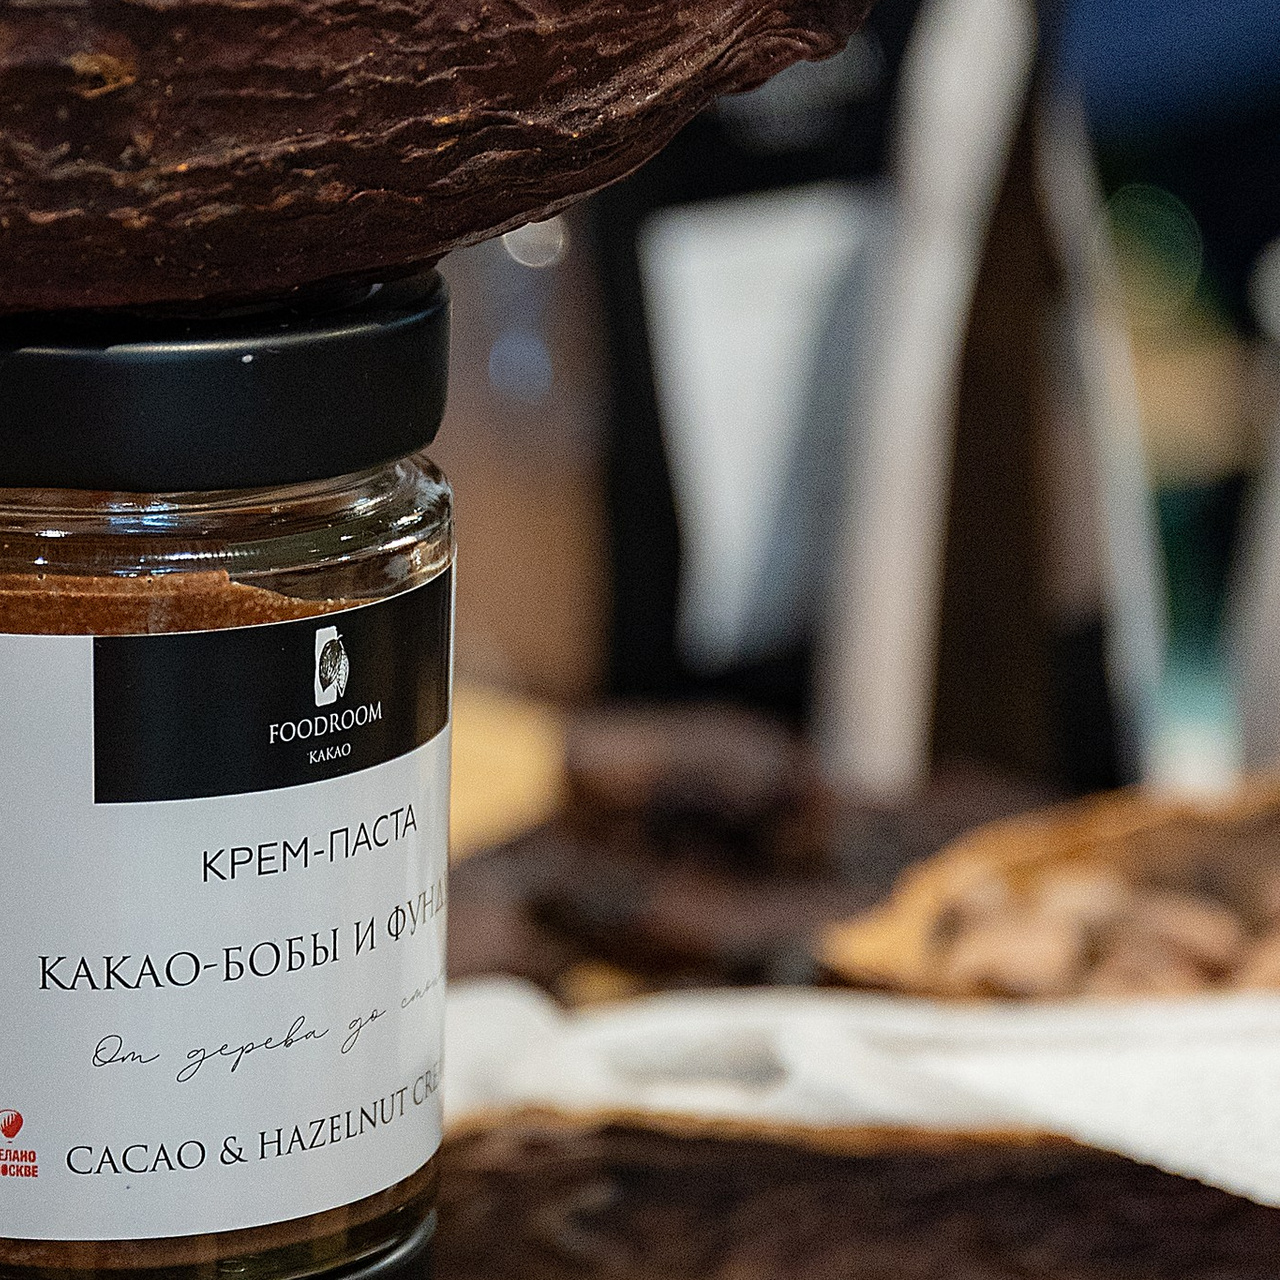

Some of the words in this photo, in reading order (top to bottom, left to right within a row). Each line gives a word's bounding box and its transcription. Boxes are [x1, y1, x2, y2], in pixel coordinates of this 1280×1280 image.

[268, 700, 383, 745] FOODROOM
[308, 742, 352, 765] КАКАО
[201, 803, 419, 883] КРЕМ-ПАСТА
[38, 926, 341, 992] КАКАО-БОБЫ
[353, 916, 377, 956] И
[387, 870, 447, 942] ФУНД
[65, 1139, 206, 1176] CACAO
[219, 1134, 248, 1166] &
[257, 1087, 408, 1161] HAZELNUT
